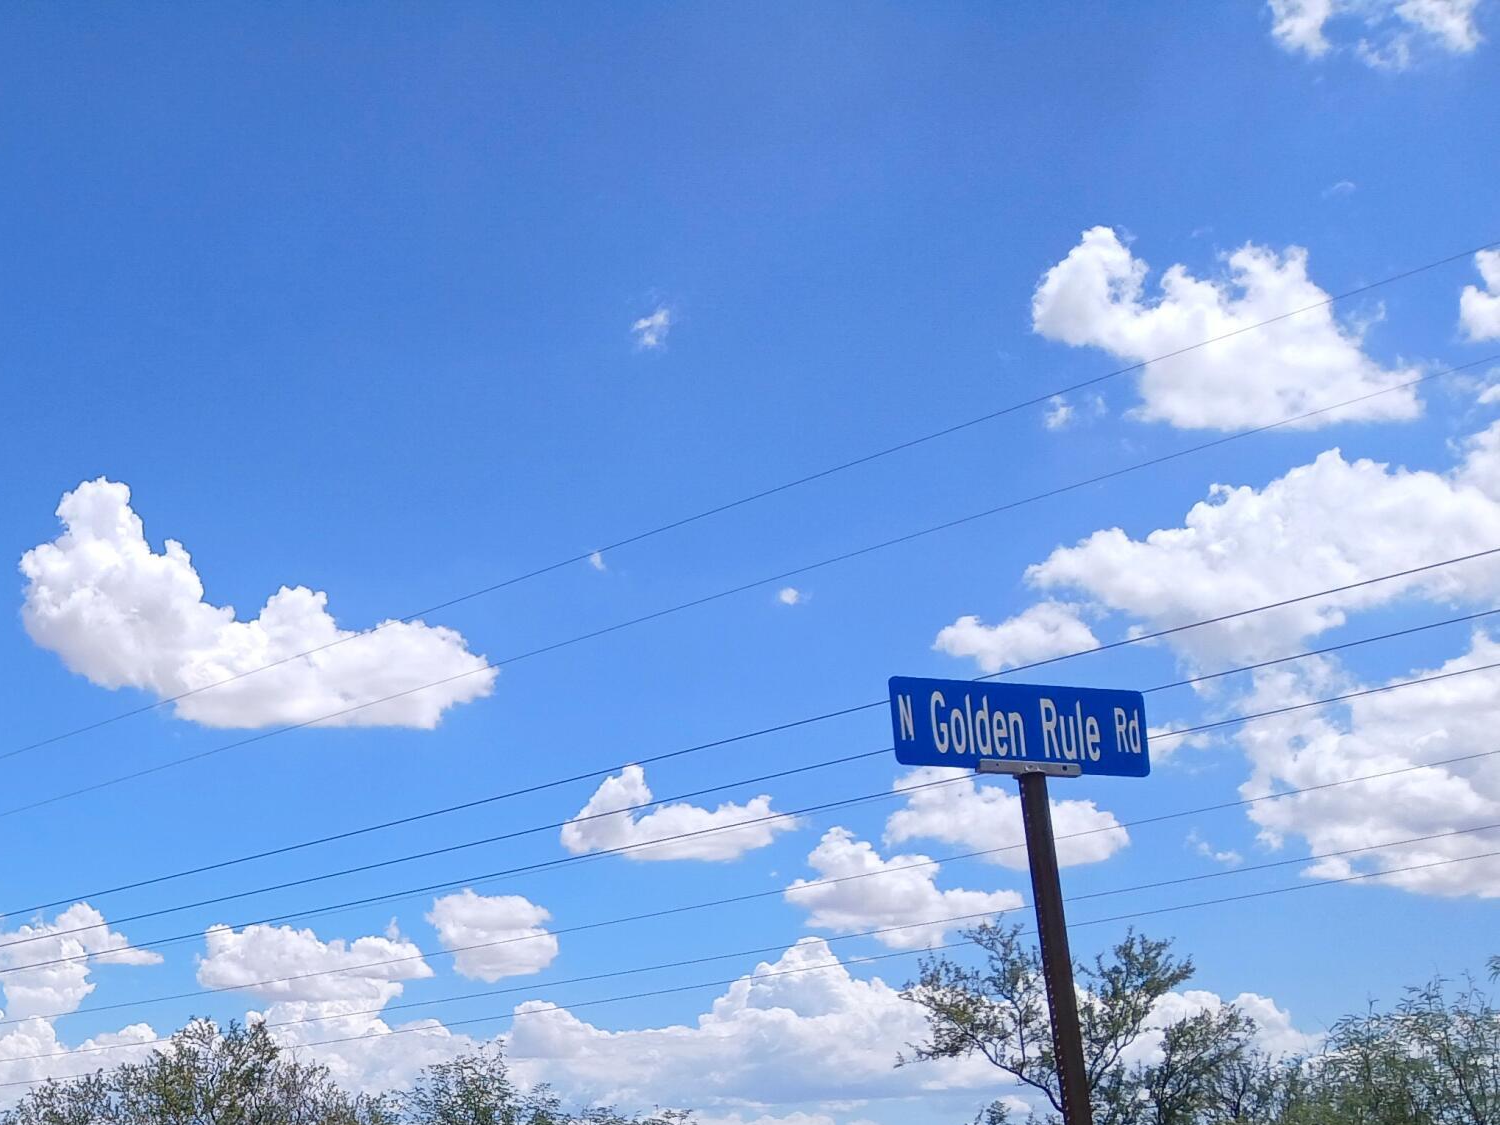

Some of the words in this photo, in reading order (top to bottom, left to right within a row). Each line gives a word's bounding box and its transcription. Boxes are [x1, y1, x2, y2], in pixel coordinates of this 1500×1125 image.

[897, 694, 915, 741] N
[930, 691, 1026, 757] Golden
[1040, 698, 1101, 762] Rule
[1114, 707, 1142, 754] Rd
